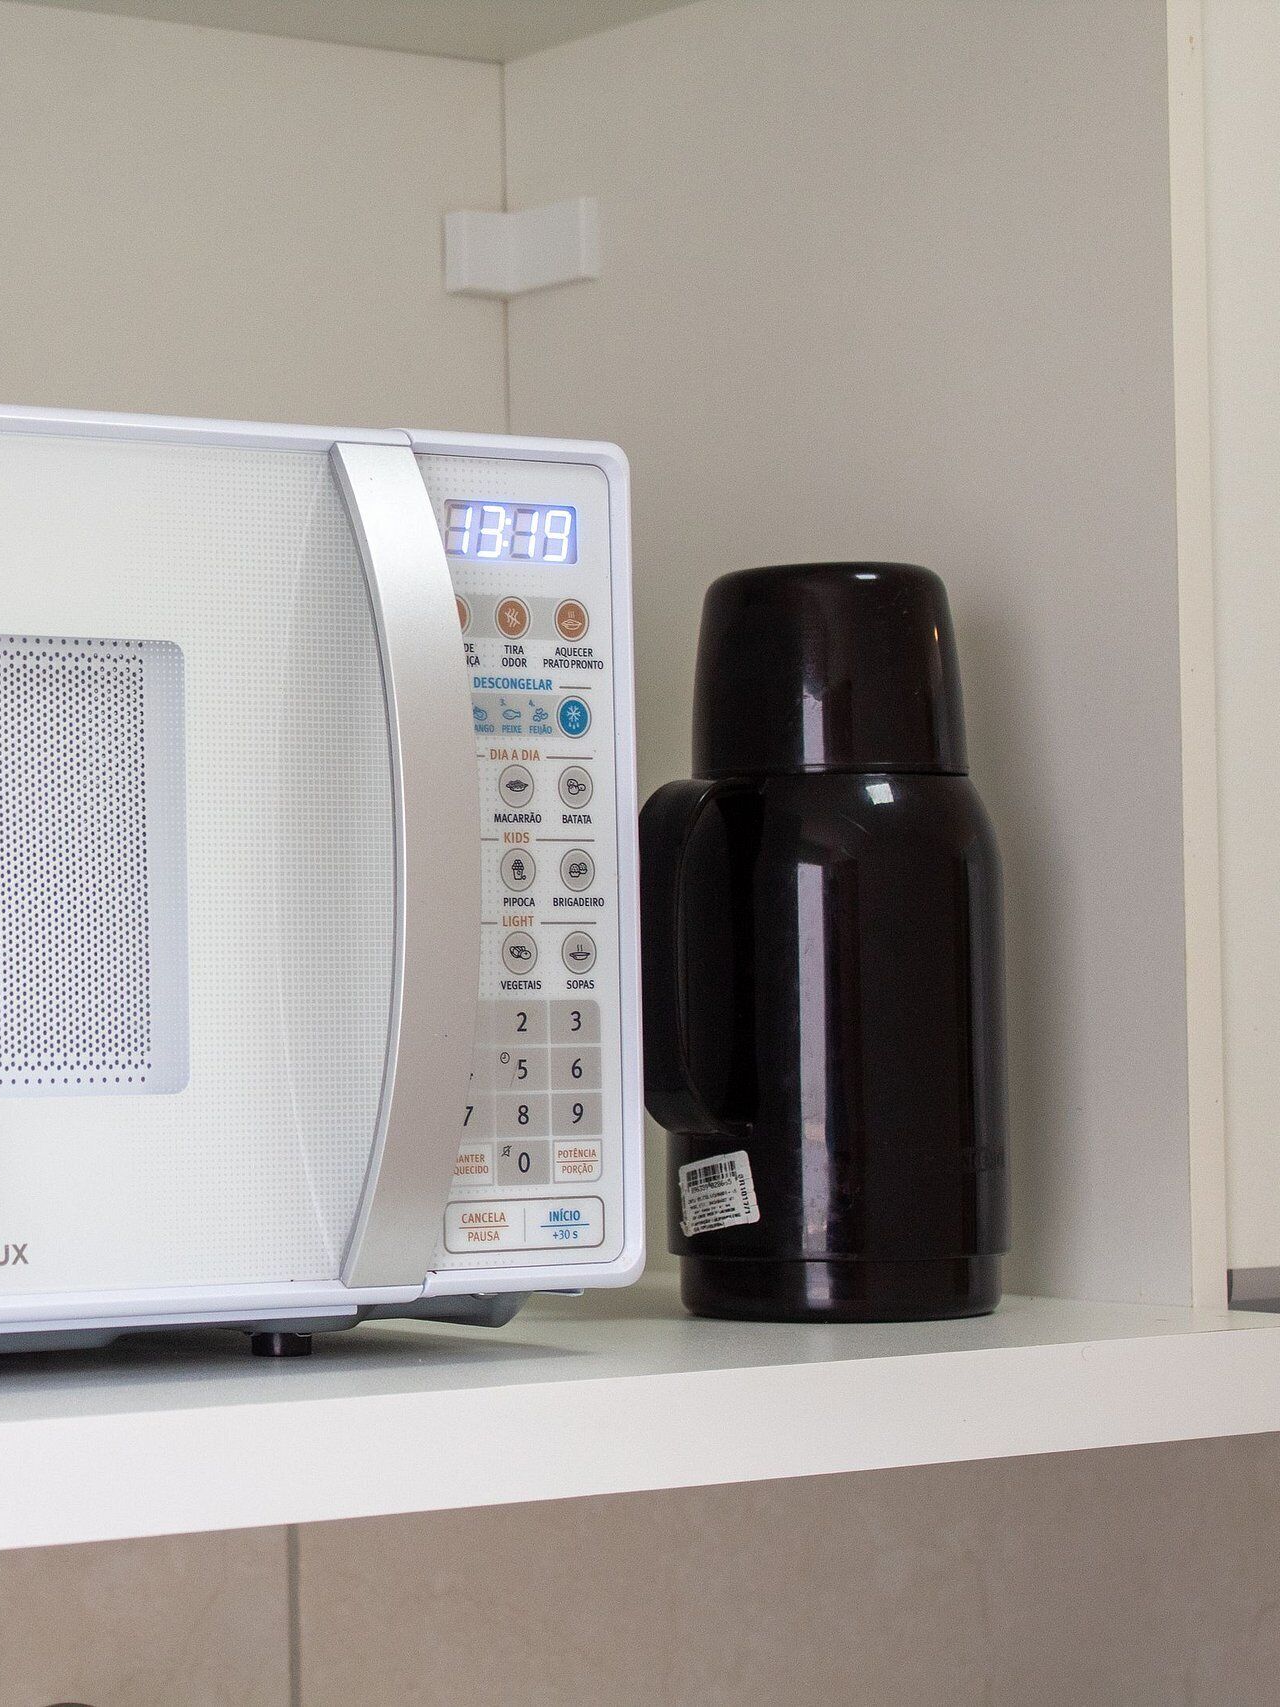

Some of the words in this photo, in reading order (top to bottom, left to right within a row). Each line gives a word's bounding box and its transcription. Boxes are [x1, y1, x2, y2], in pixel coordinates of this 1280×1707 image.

[461, 505, 572, 562] 13:19
[504, 645, 525, 655] TIRA
[555, 647, 593, 658] AQUECER
[501, 657, 527, 668] ODOR
[543, 659, 570, 669] PRATO
[571, 659, 604, 670] PRONTO
[473, 677, 553, 691] DESCONGELAR
[502, 725, 523, 734] PEIXE
[529, 723, 553, 735] FEIJÃO
[490, 749, 508, 761] DIA
[510, 750, 519, 761] A
[521, 750, 541, 761] DIA
[494, 811, 542, 823] MACARRÃO
[562, 814, 592, 824] BATATA
[504, 832, 530, 844] KIDS
[503, 898, 535, 907] PIPOCA
[553, 898, 605, 907] BRIGADEIRO
[502, 916, 534, 927] LIGHT
[501, 981, 542, 990] VEGETAIS
[566, 980, 595, 990] SOPAS
[516, 1011, 528, 1032] 2
[570, 1010, 582, 1031] 3
[517, 1059, 528, 1080] 5
[571, 1058, 583, 1079] 6
[463, 1105, 474, 1127] 7
[517, 1104, 529, 1125] 8
[572, 1103, 584, 1124] 9
[456, 1153, 485, 1164] ANTER
[558, 1147, 597, 1159] POTÊNCIA
[518, 1151, 531, 1173] 0
[562, 1163, 593, 1175] PORÇÃO
[461, 1211, 506, 1224] CANCELA
[549, 1207, 581, 1222] INÍCIO
[468, 1231, 500, 1242] PAUSA
[553, 1230, 571, 1240] +30
